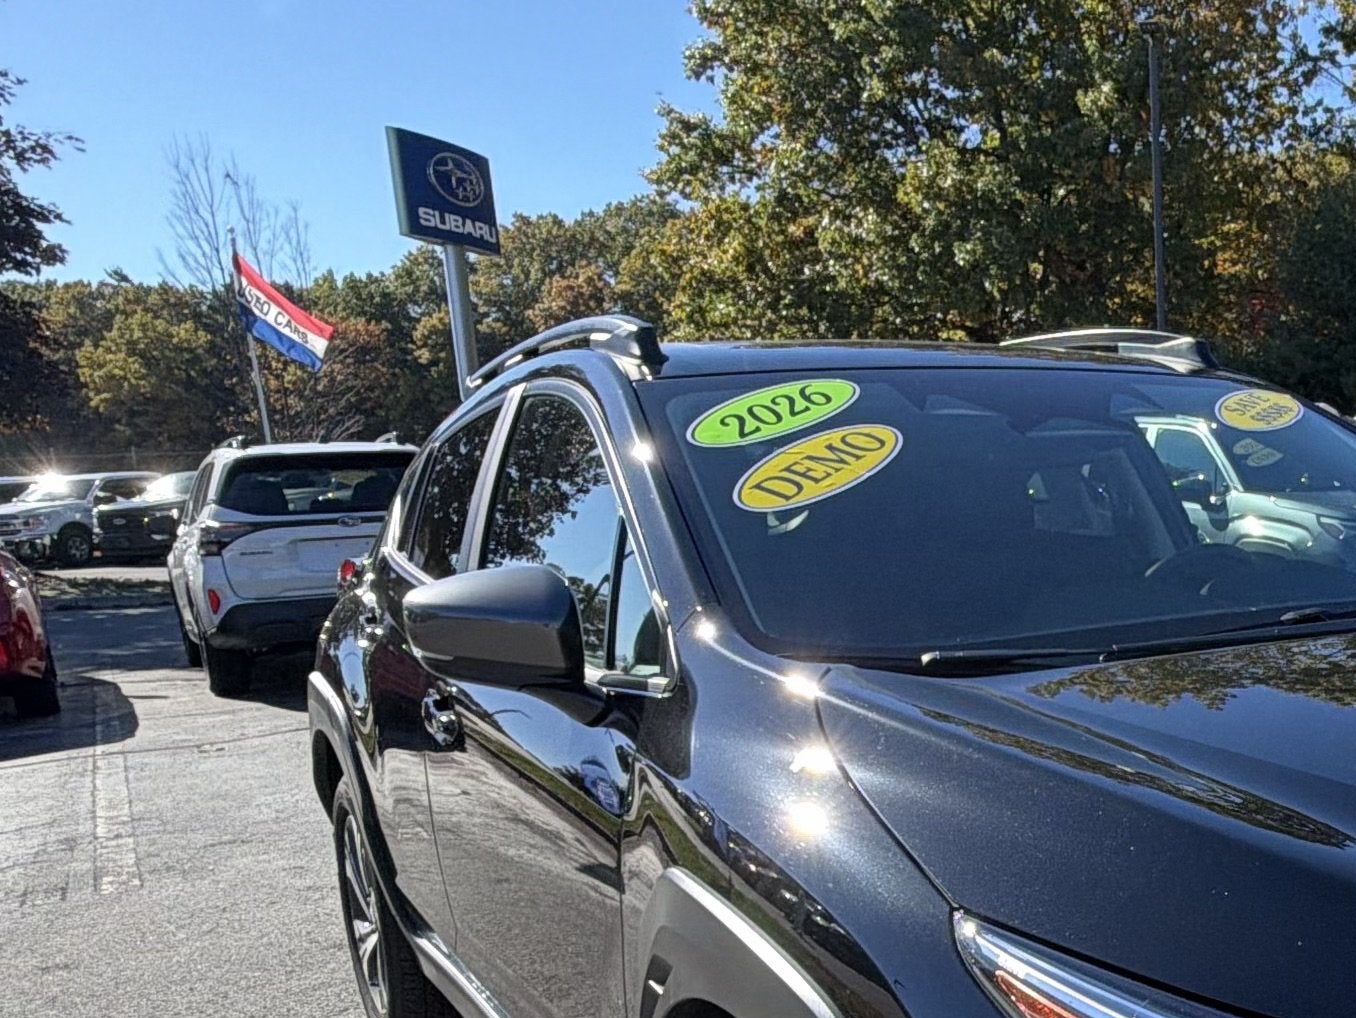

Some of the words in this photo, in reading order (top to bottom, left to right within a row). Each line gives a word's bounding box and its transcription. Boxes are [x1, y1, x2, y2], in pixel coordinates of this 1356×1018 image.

[418, 206, 497, 243] SUBARU
[274, 311, 309, 344] CARS
[719, 384, 833, 440] 2026
[1223, 393, 1271, 417] SAVE
[751, 431, 886, 502] DEMO
